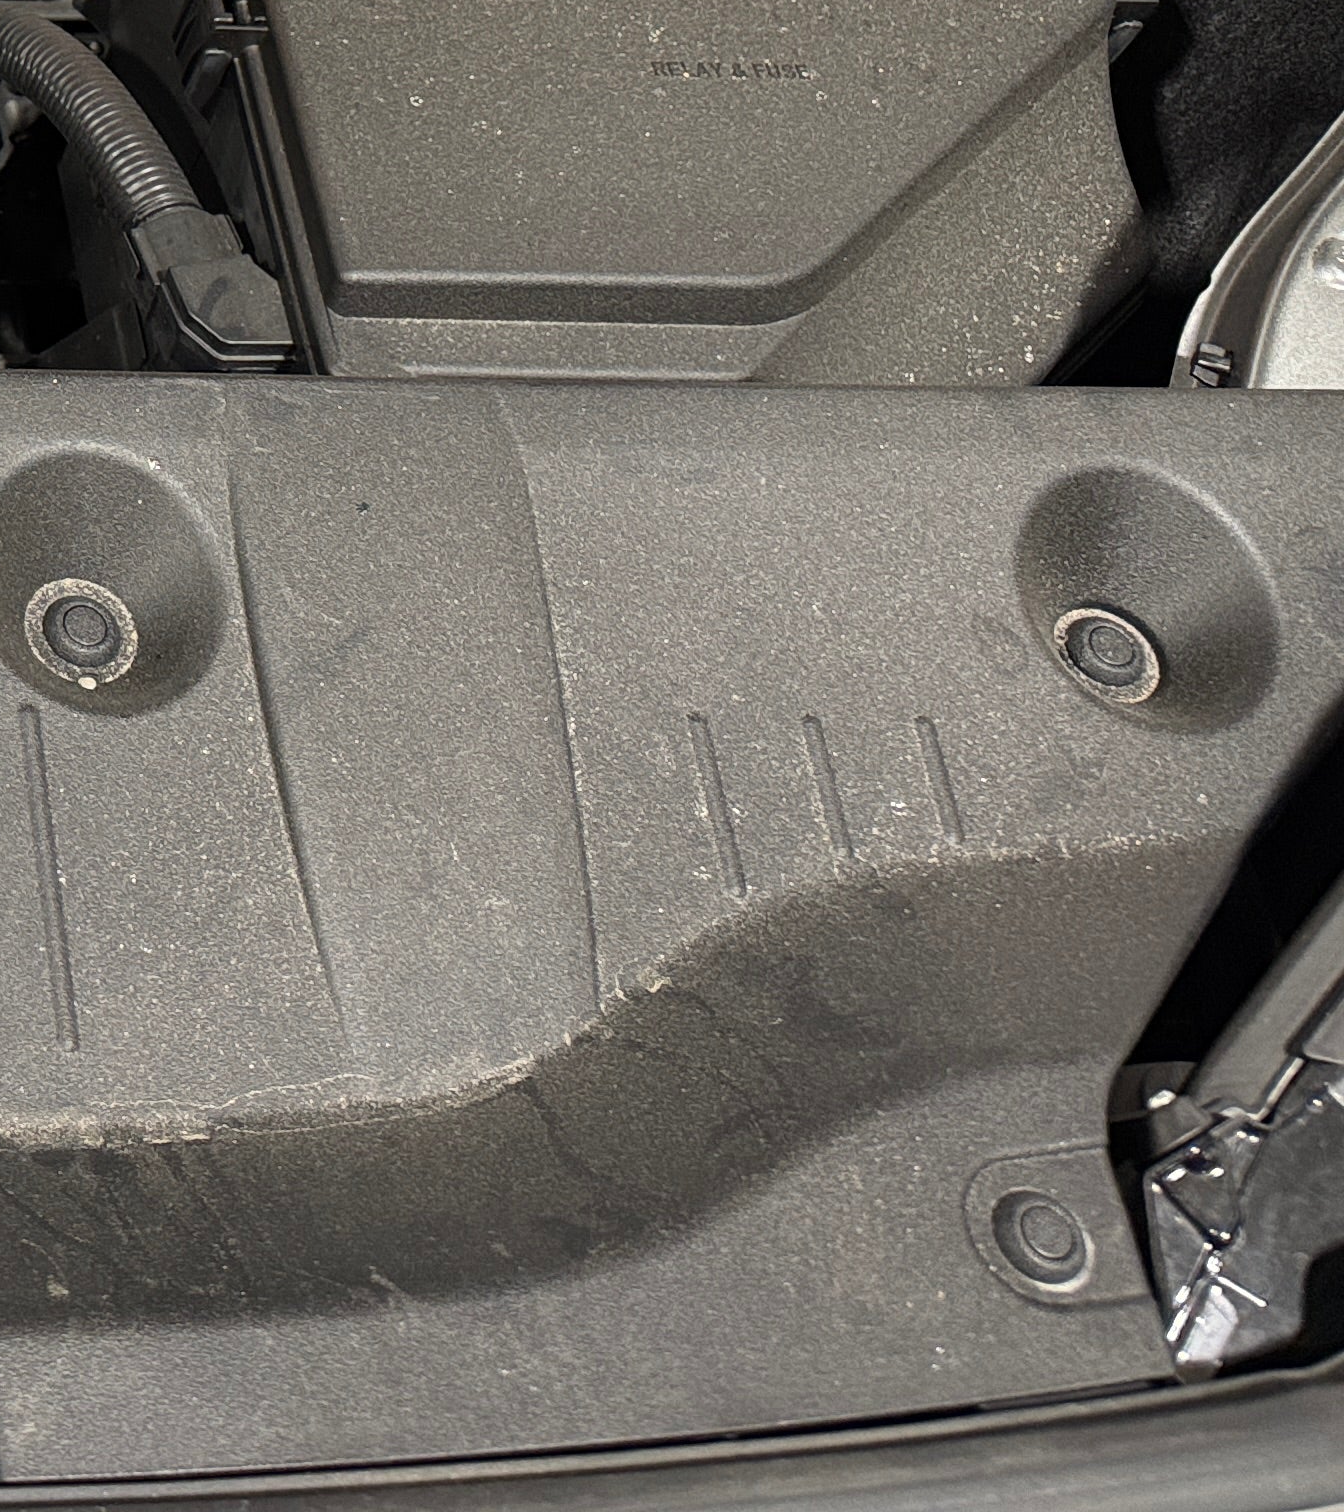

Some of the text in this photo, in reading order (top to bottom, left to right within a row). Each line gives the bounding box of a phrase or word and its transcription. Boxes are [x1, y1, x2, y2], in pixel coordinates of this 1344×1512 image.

[650, 61, 811, 80] RELAY & FUSE
